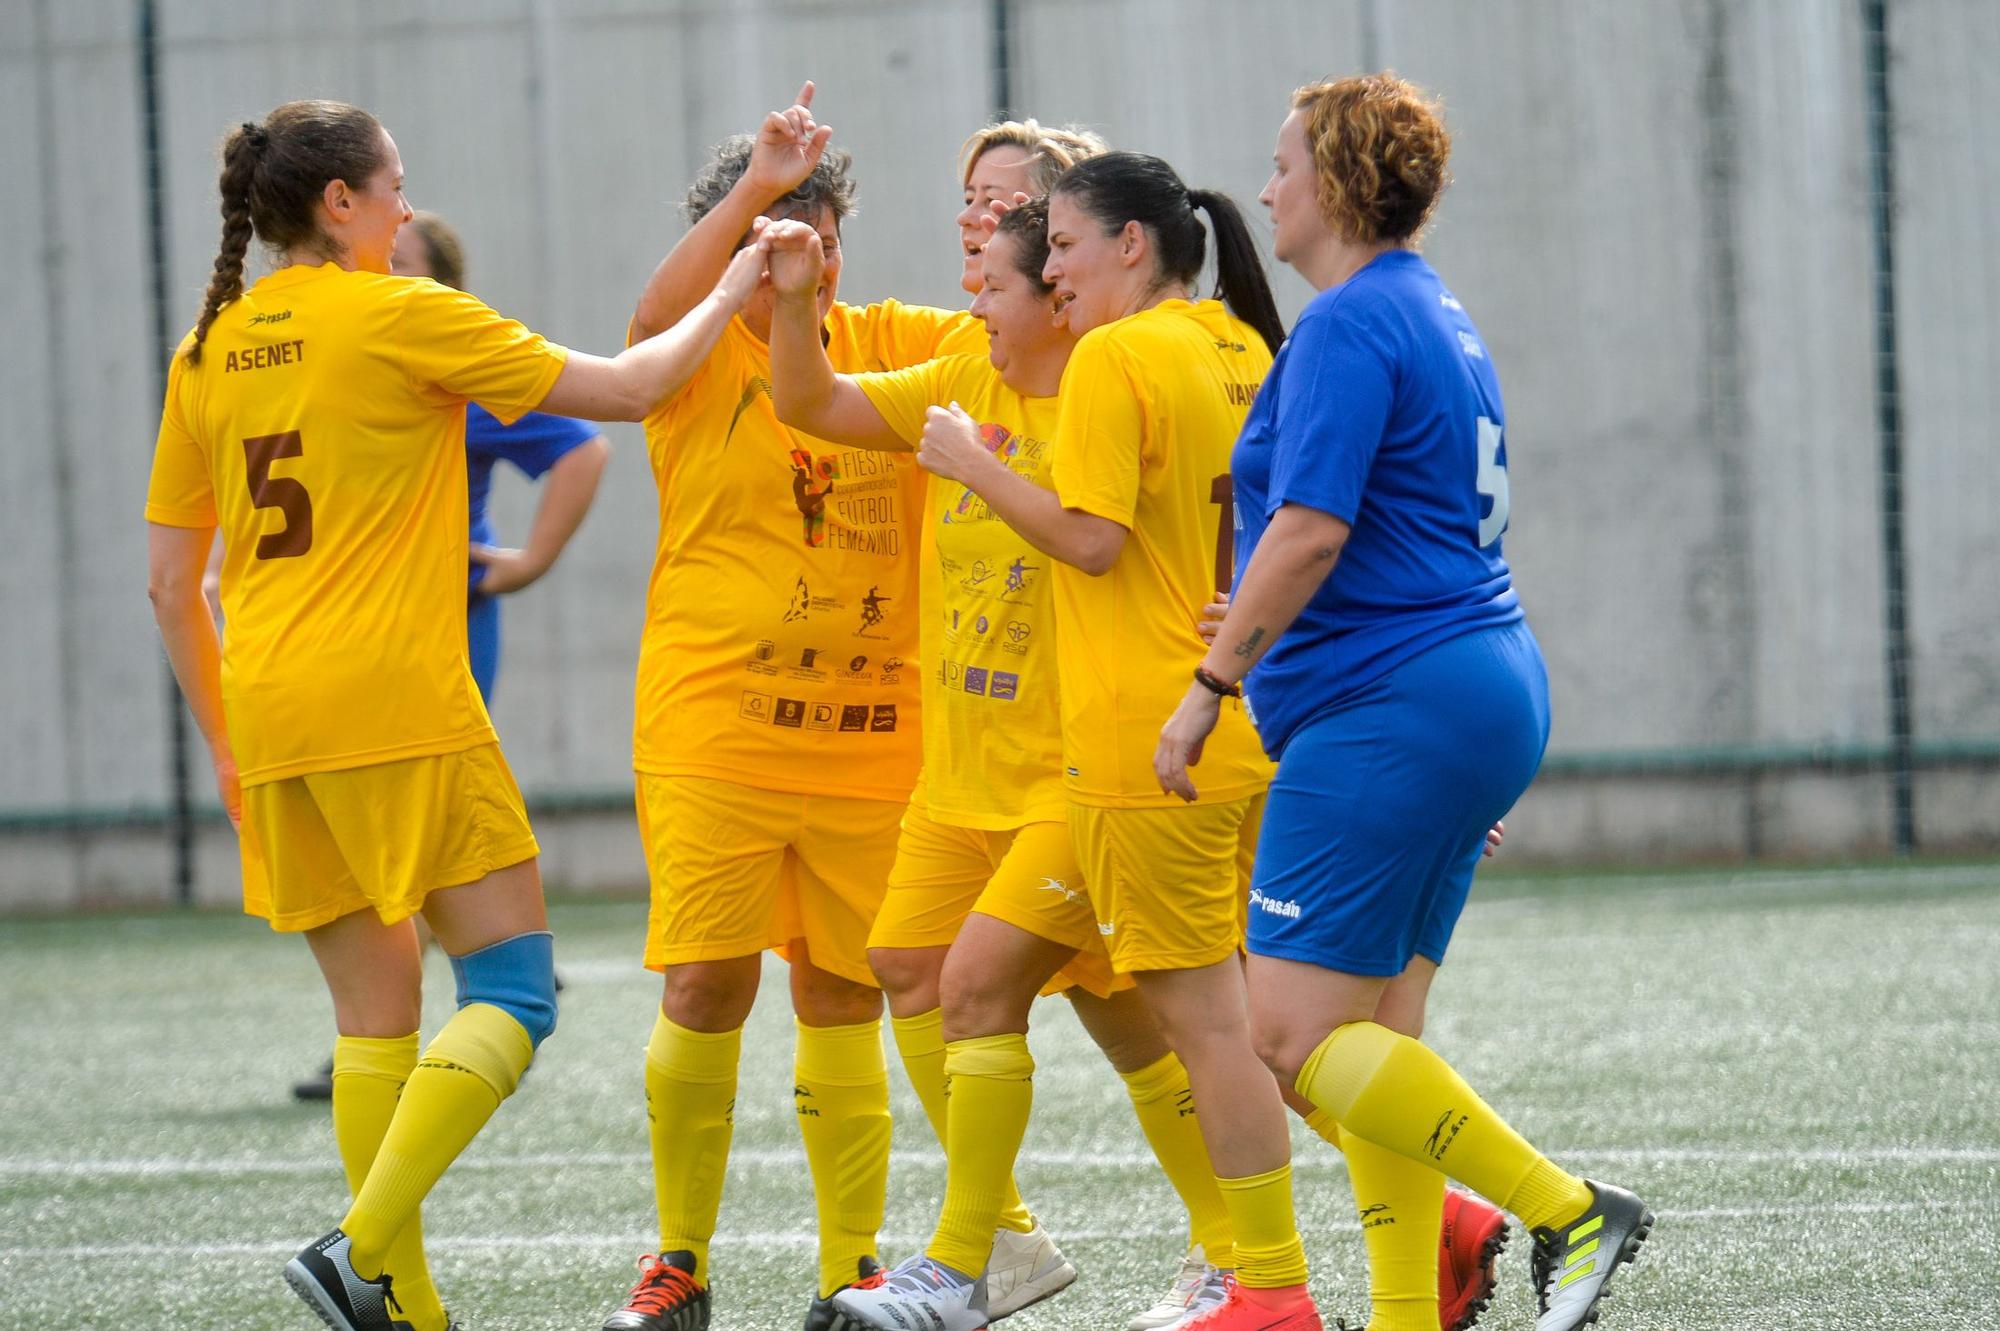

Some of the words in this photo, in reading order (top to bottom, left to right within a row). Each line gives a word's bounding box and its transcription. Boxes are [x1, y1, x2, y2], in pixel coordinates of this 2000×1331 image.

[225, 339, 304, 373] ASENET
[842, 449, 896, 478] FIESTA
[242, 429, 313, 560] 5
[1477, 415, 1510, 548] 5
[837, 495, 898, 525] FÚTBOL
[828, 523, 899, 557] FEMENINO
[1262, 896, 1301, 918] rasán
[1434, 1115, 1468, 1160] rasán
